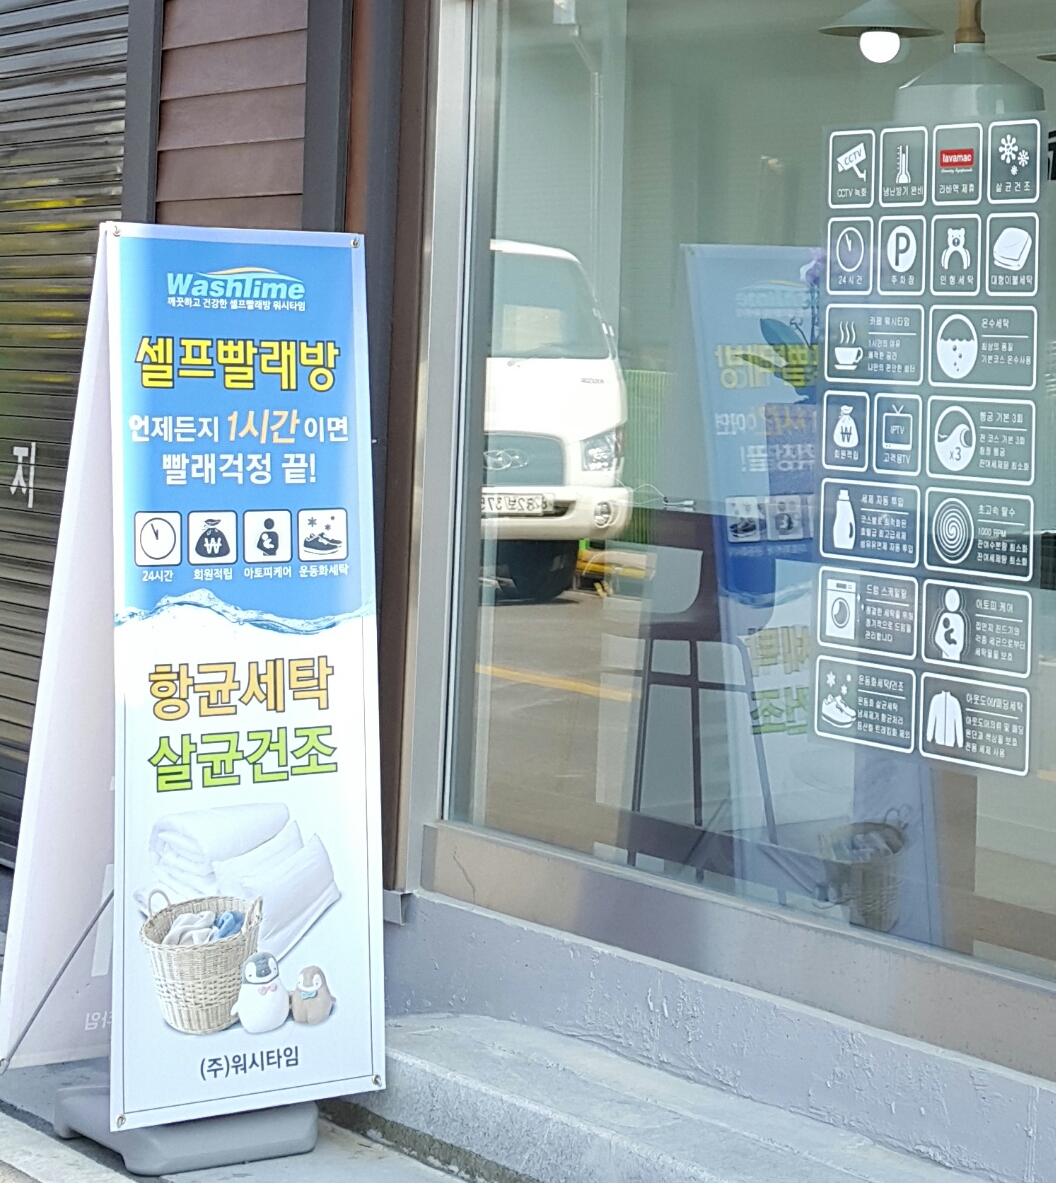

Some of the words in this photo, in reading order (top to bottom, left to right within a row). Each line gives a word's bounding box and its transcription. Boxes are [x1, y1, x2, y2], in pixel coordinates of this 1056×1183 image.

[844, 150, 863, 165] CCTV
[942, 153, 972, 163] lavamac
[837, 188, 853, 198] CCTV
[167, 272, 306, 300] WashTime
[203, 299, 227, 309] 건강한
[981, 318, 1010, 329] 온수세탁
[134, 335, 341, 392] 셀프빨래방
[129, 415, 219, 444] 언제든지
[890, 425, 906, 435] IPTV
[162, 452, 272, 486] 빨래걱정
[281, 452, 317, 485] 끝!
[142, 570, 174, 583] 24시간
[193, 568, 233, 581] 회원적립
[243, 566, 292, 580] 아토피케어
[298, 563, 349, 578] 운동화세탁
[148, 655, 334, 722] 항균세탁
[148, 724, 338, 793] 살균건조
[199, 1045, 300, 1081] (주)워시타임
